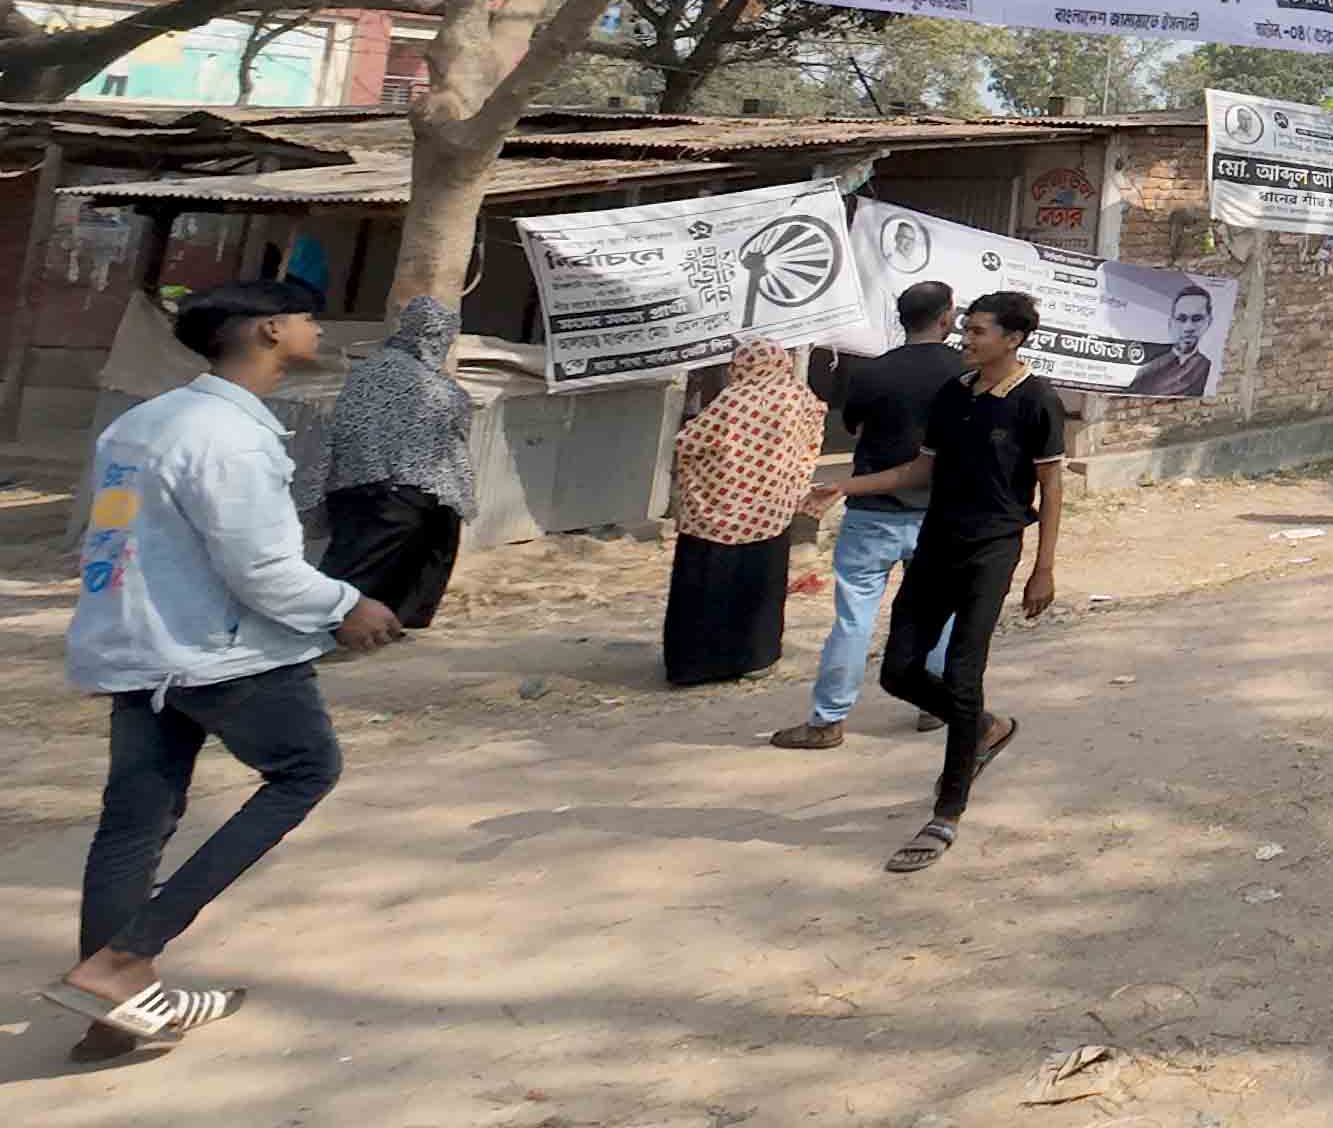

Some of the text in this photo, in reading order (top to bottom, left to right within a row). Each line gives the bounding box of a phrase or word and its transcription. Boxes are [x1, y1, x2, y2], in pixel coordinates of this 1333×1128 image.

[1217, 158, 1249, 178] মো.
[1255, 163, 1308, 187] আব্দুল
[1060, 334, 1127, 359] আজিজ
